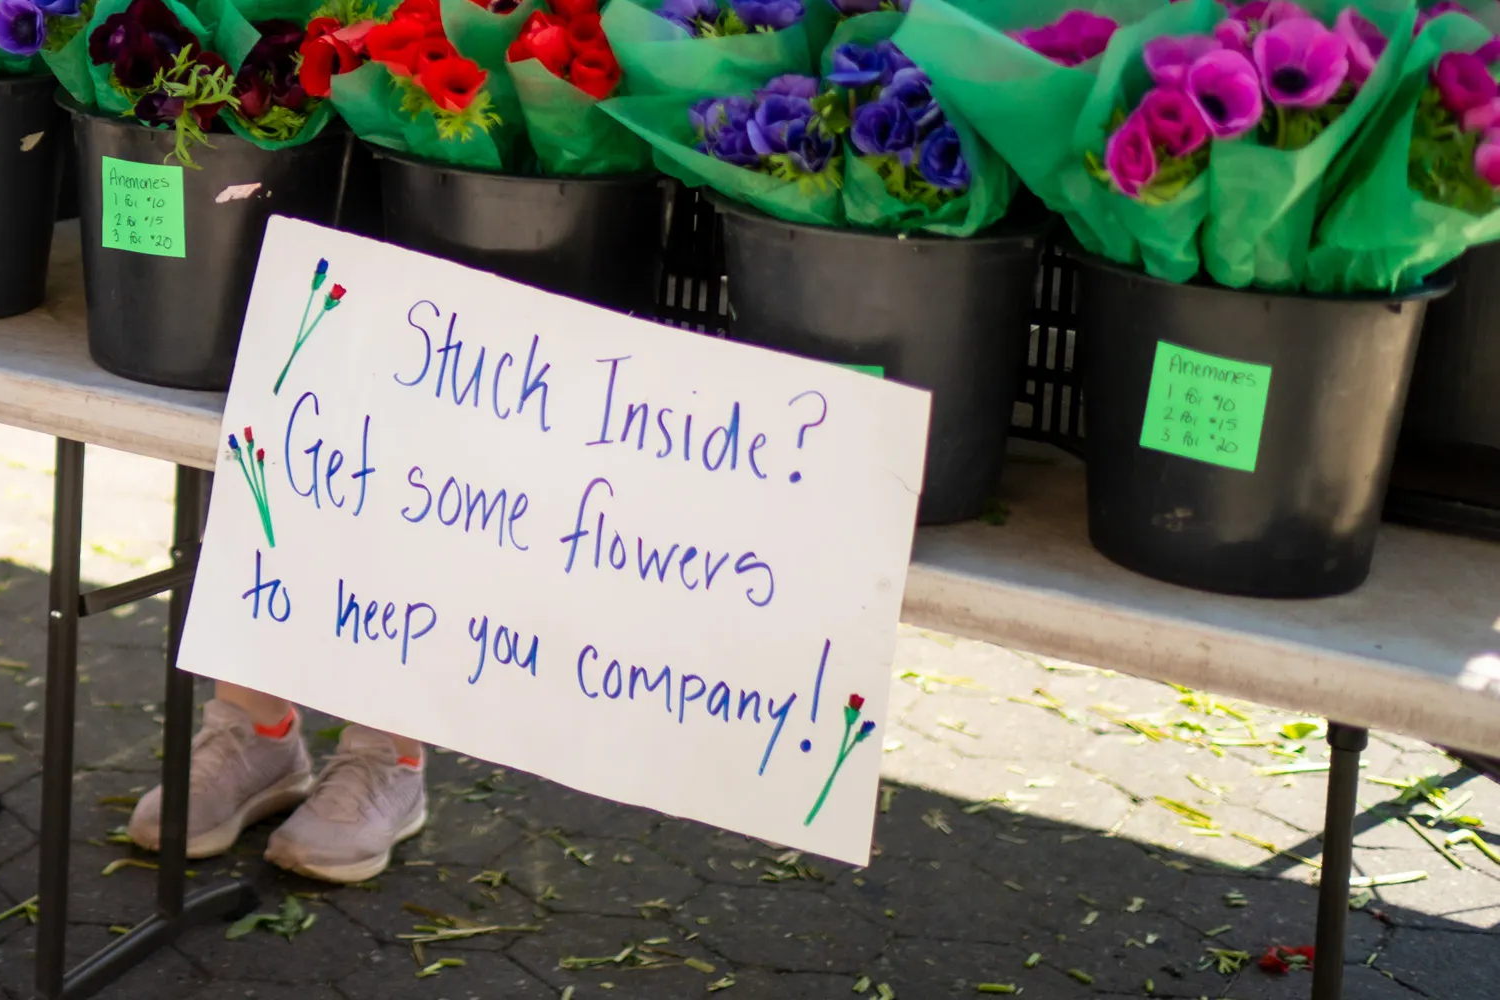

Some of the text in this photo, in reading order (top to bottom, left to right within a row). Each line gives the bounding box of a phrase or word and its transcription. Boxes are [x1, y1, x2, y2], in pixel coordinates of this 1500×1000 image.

[109, 166, 170, 190] Anemones
[113, 192, 118, 206] 1
[114, 212, 122, 226] 2
[112, 228, 120, 243] 3
[1169, 353, 1257, 387] Anemones
[394, 299, 828, 483] Stuck Inside?
[1168, 383, 1173, 400] 1
[1163, 406, 1174, 421] 2
[1161, 427, 1171, 442] 3
[284, 390, 776, 607] Get some flowers
[241, 549, 292, 623] to
[468, 614, 540, 685] you
[577, 638, 832, 777] company!
